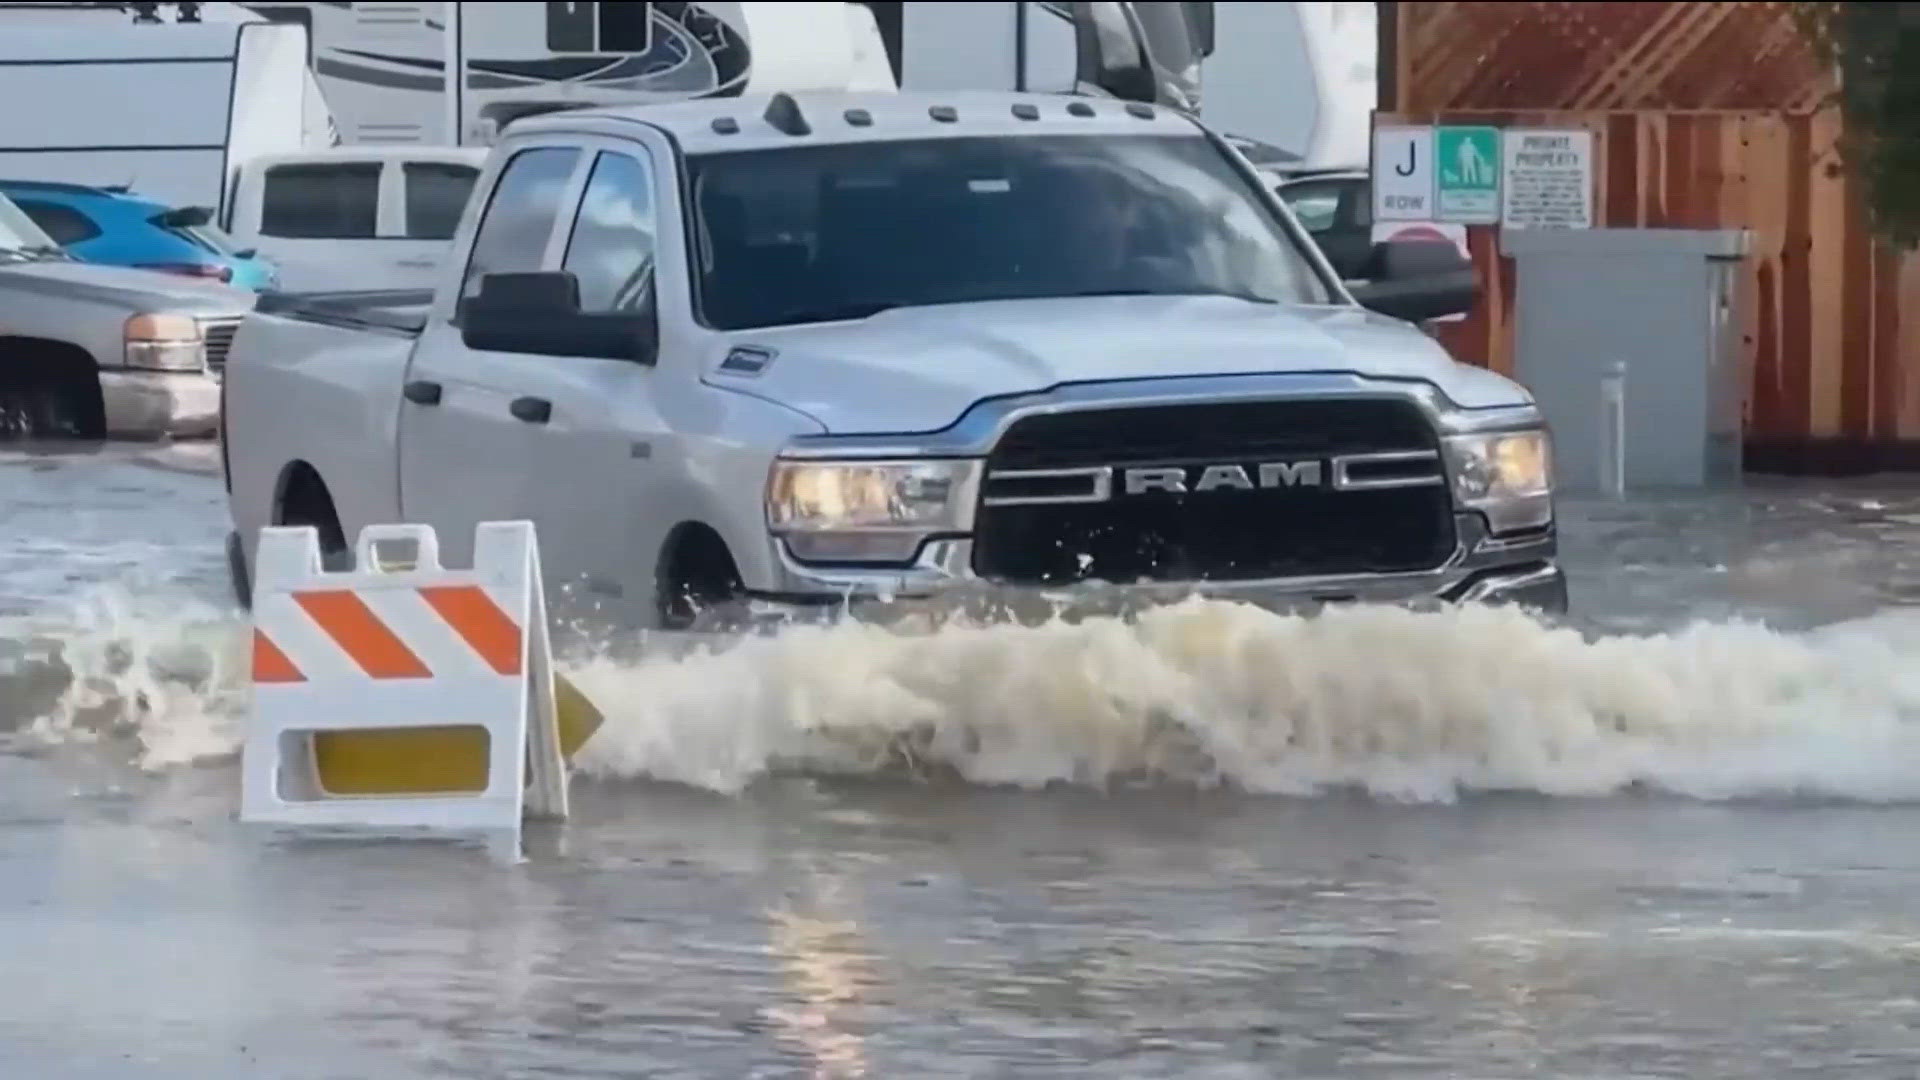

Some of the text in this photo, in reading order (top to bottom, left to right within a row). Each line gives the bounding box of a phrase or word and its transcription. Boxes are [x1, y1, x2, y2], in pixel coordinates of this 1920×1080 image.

[1396, 140, 1416, 177] J
[1384, 195, 1424, 210] ROW
[1125, 461, 1322, 494] RAM
